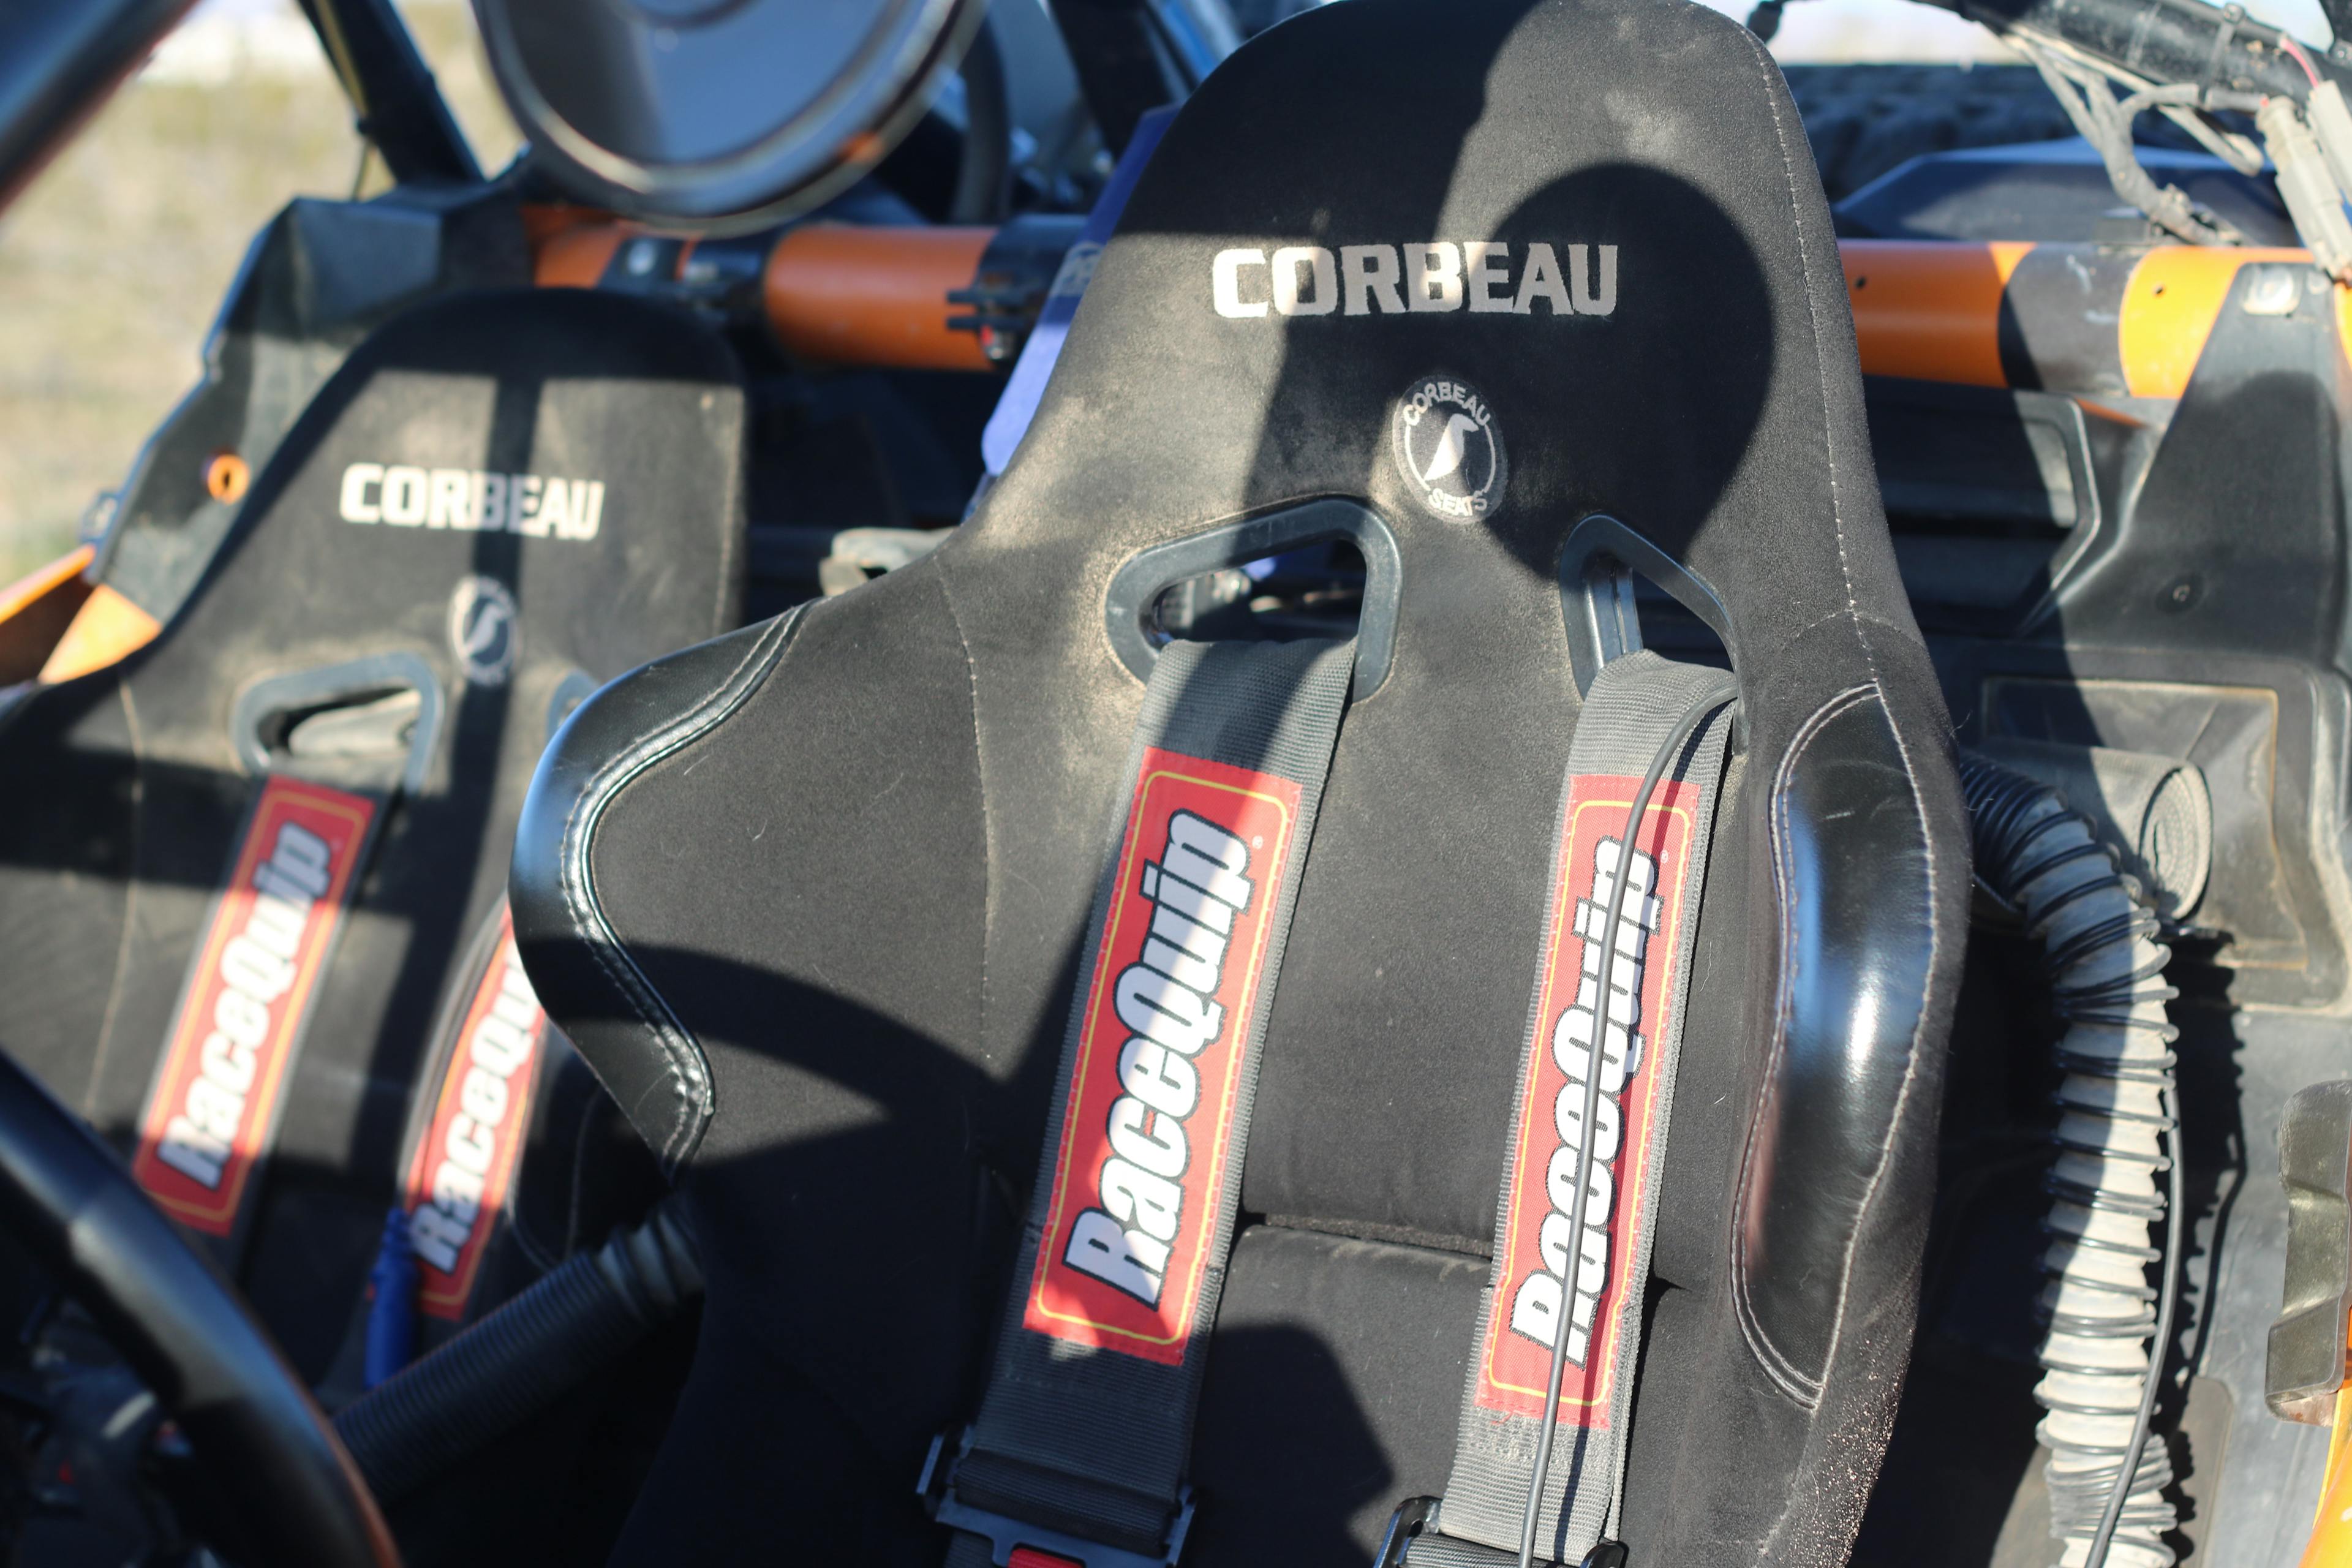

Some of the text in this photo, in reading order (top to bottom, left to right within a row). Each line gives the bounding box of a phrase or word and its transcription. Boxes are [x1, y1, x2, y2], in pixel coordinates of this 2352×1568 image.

[1212, 241, 1618, 318] CORBEAU
[1403, 382, 1491, 426] CORBEAU
[340, 462, 606, 540] CORBEAU
[1428, 488, 1487, 516] SEATS
[155, 818, 331, 1192] RaceQuip
[1062, 807, 1256, 1312] RaceQuip
[408, 937, 540, 1275] RaceQu
